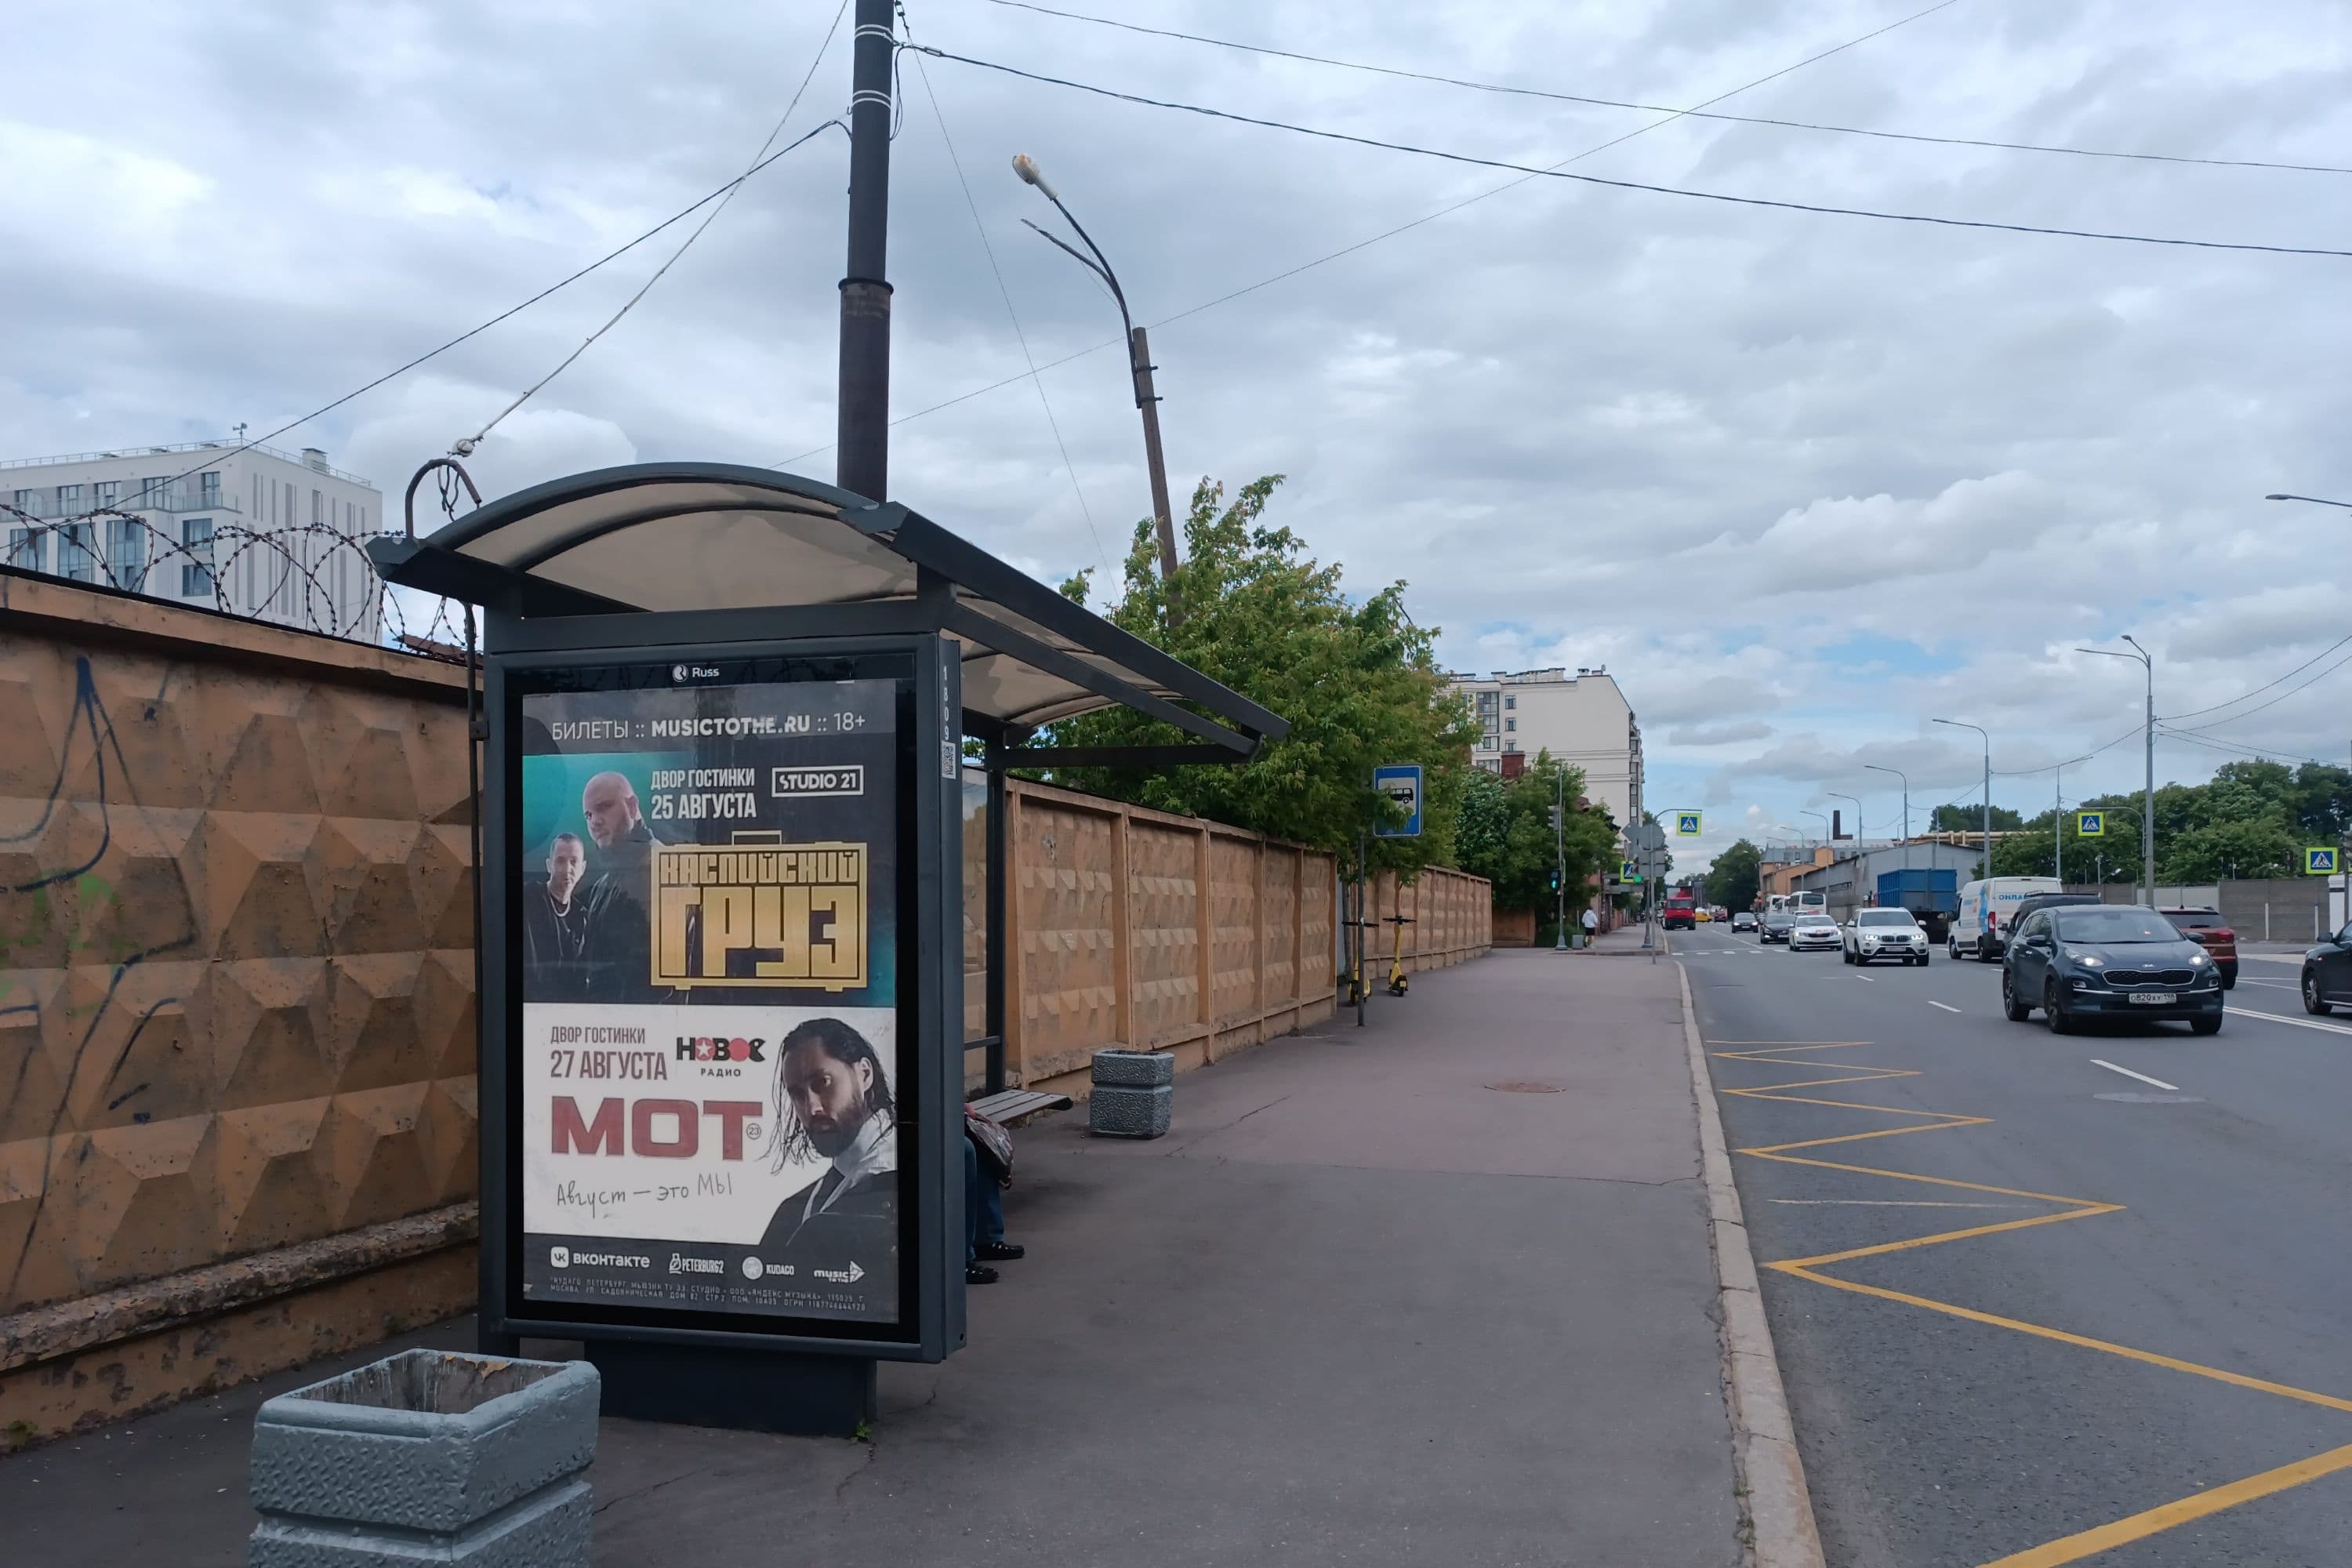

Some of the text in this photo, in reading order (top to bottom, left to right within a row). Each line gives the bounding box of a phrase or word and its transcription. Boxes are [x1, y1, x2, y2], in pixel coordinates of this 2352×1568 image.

[692, 667, 720, 678] Russ
[552, 719, 629, 740] БИЛЕТЫ
[652, 714, 810, 738] MUSICTOTHE.RU
[833, 712, 866, 731] 18+
[651, 768, 755, 790] ДВОР ГОСТИНКИ
[779, 772, 856, 790] STUDIO 21
[651, 792, 757, 820] 25 АВГУСТА
[660, 851, 858, 884] КАСПИЙСКИЙ
[660, 885, 858, 978] ГРУЗ
[550, 1026, 645, 1044] ДВОР ГОСТИНКИ
[550, 1050, 668, 1080] 27 АВГУСТА
[700, 1068, 741, 1078] РАДИО
[551, 1095, 764, 1161] МОТ
[557, 1180, 626, 1218] Август
[656, 1186, 689, 1201] это
[697, 1172, 733, 1196] МЫ
[766, 1264, 794, 1276] KUDAGO
[814, 1269, 849, 1279] music
